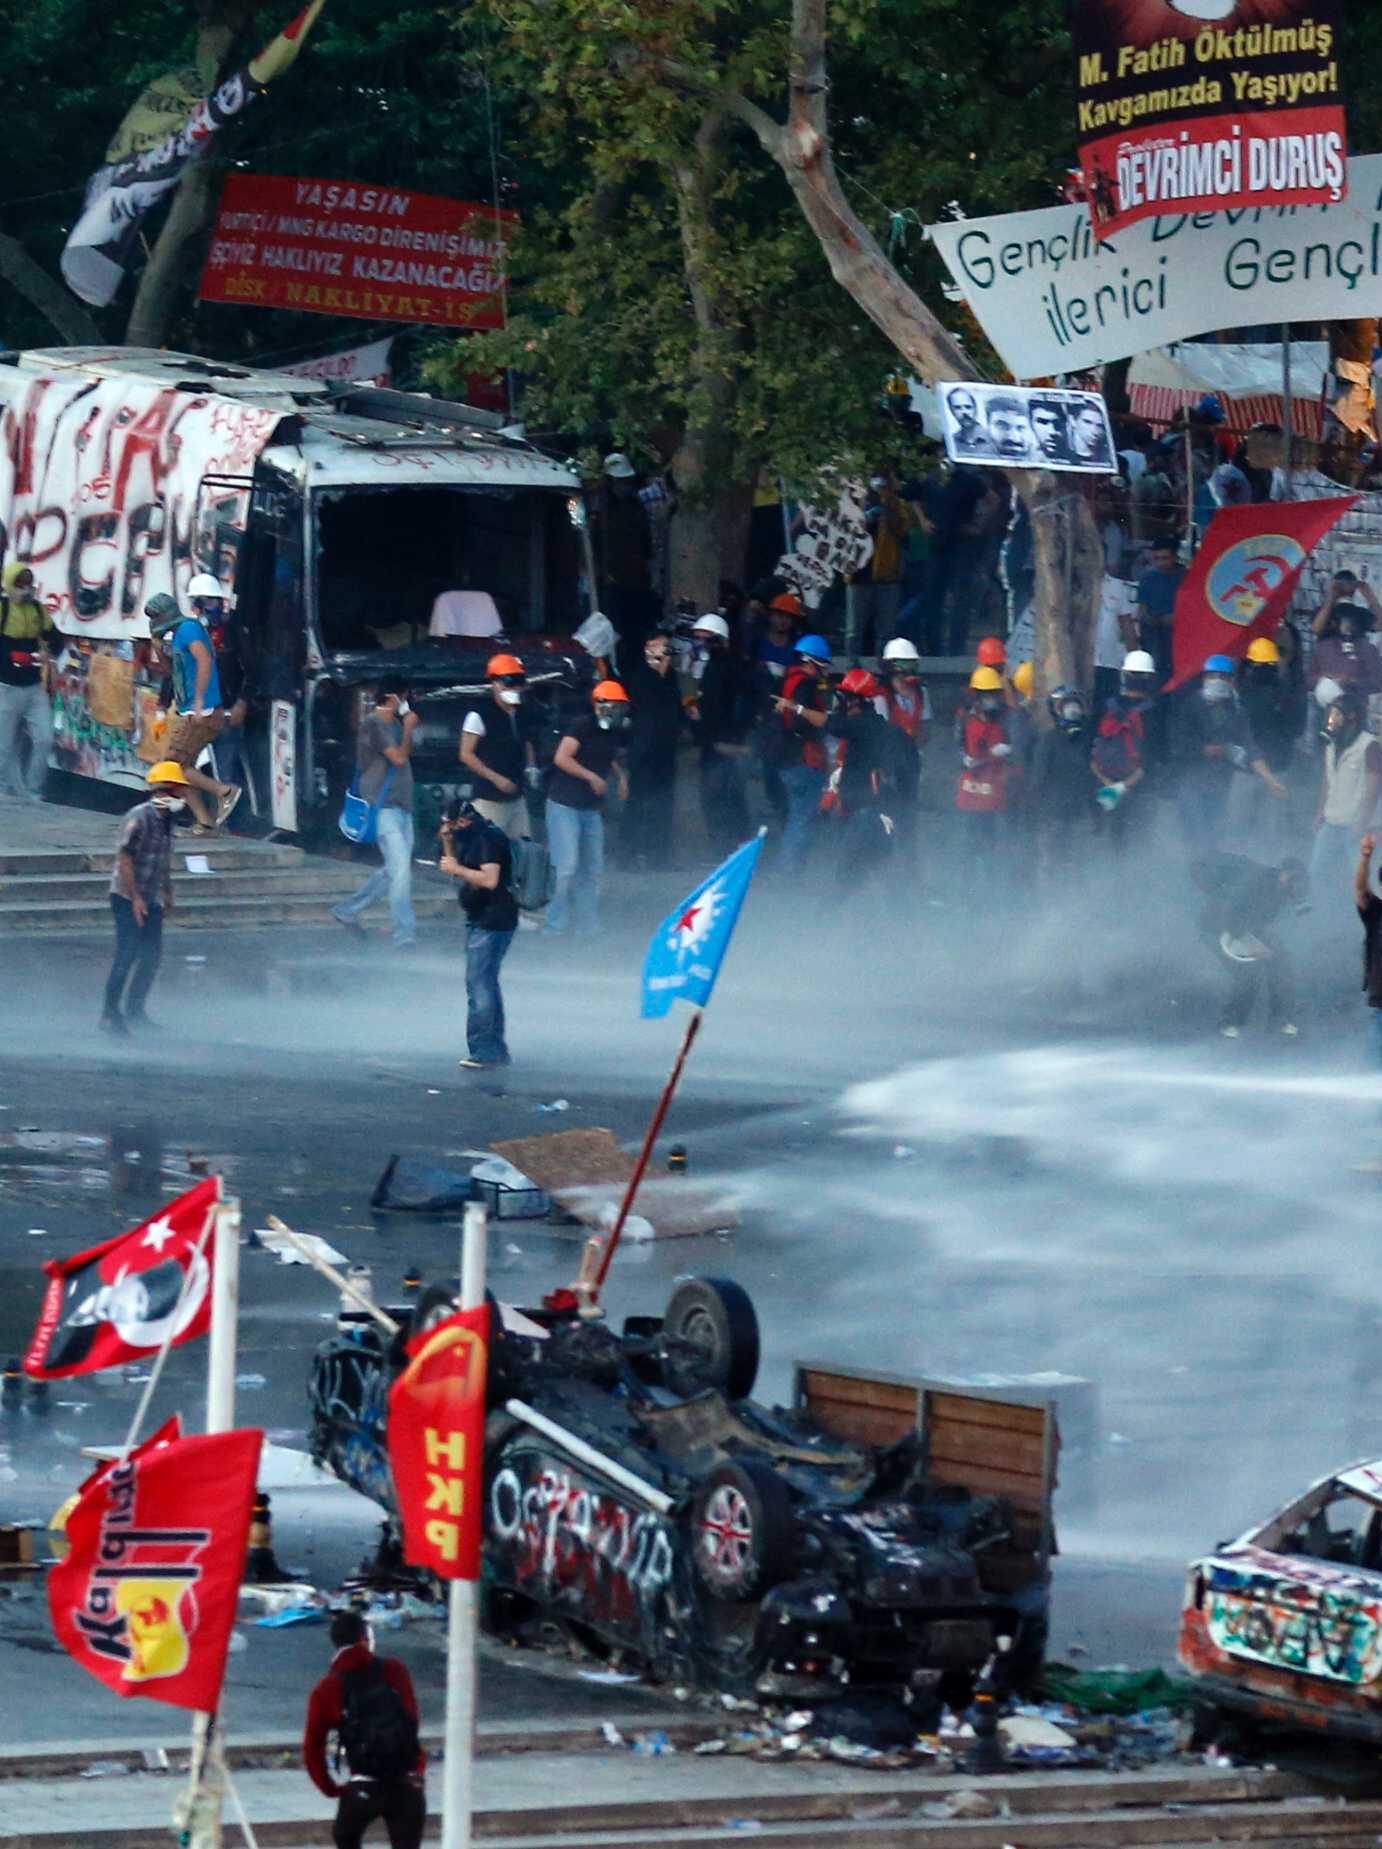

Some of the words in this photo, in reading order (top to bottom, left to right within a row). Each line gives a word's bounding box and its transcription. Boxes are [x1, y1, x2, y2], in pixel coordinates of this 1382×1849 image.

[1079, 52, 1110, 87] M.
[1117, 37, 1186, 78] Fatih
[1195, 18, 1334, 63] Öktülmüş
[1078, 76, 1223, 132] Kavgamızda
[1230, 62, 1339, 105] Yaşıyor!
[296, 183, 411, 216] YAŞASIN
[1117, 124, 1243, 212] DEVRİMCİ
[1248, 131, 1346, 202] DURUŞ
[315, 219, 379, 246] KARGO
[1152, 204, 1328, 242] Dev
[1041, 255, 1170, 347] ilerici
